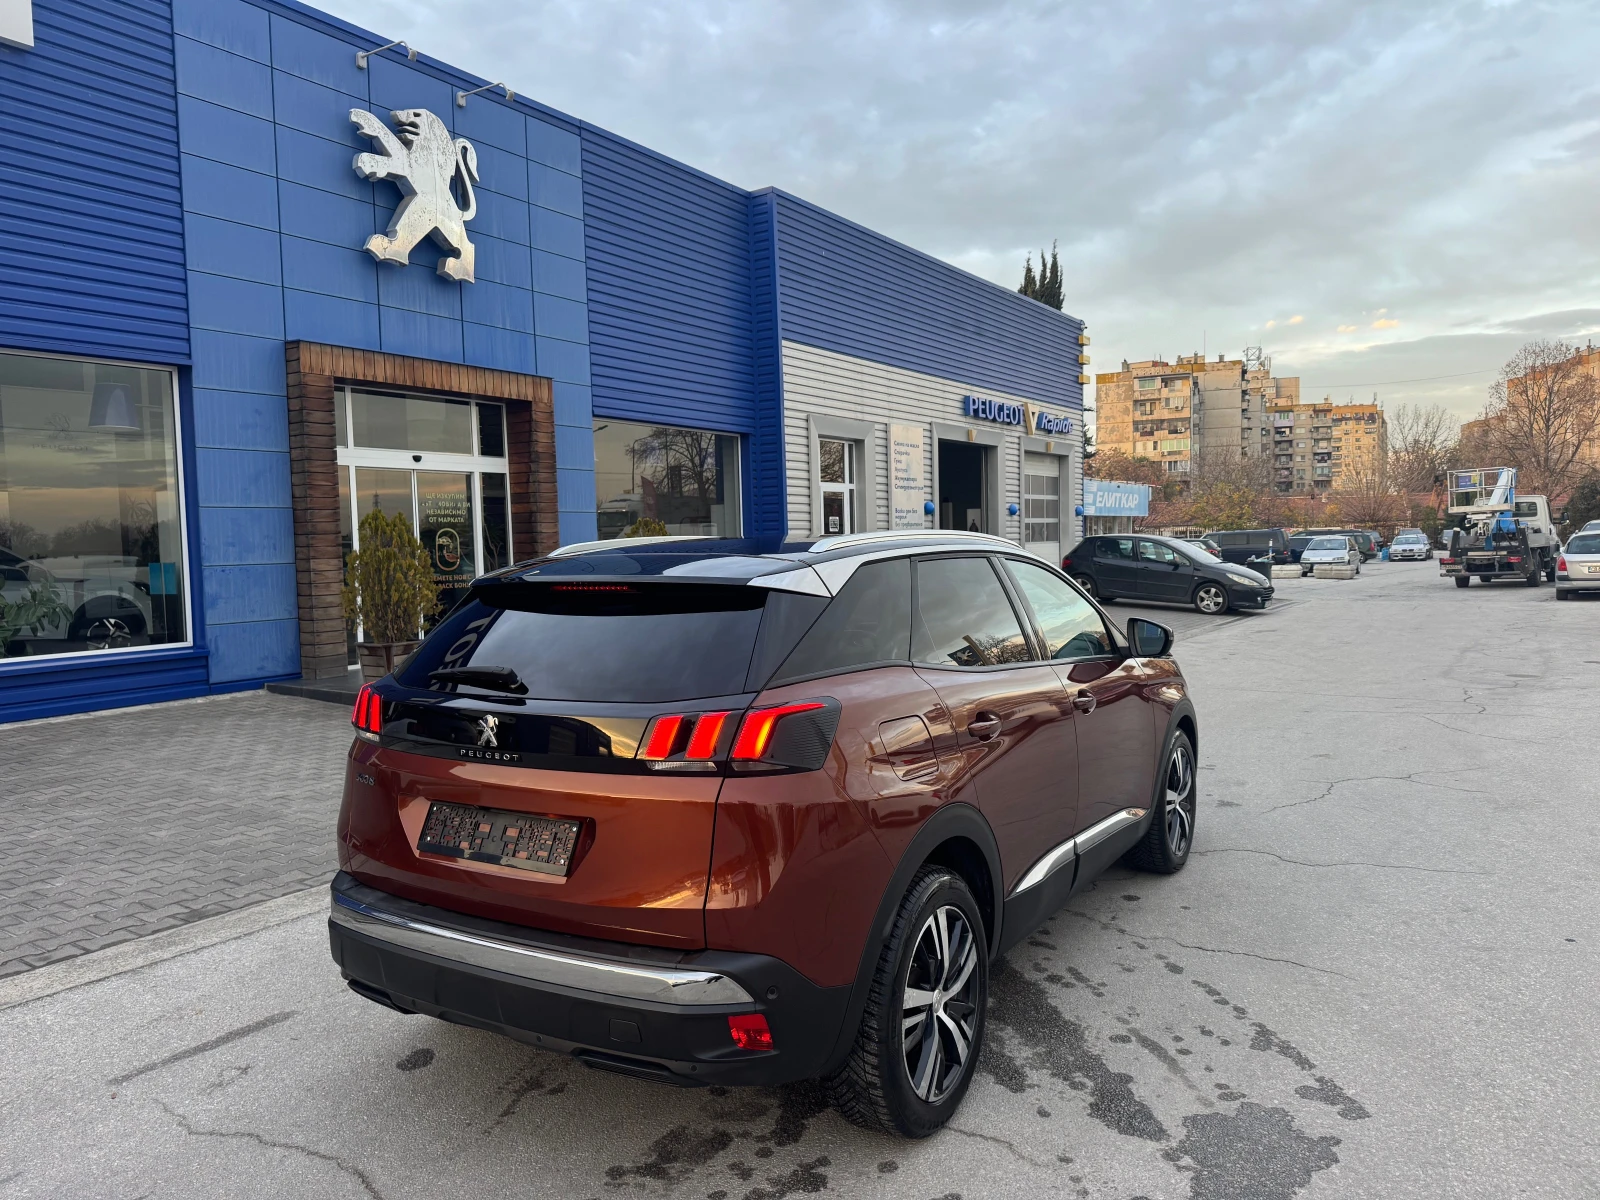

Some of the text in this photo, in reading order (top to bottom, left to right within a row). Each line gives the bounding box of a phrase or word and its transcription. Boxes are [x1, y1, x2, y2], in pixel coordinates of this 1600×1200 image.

[966, 395, 1074, 434] PEUGEOT Rapide
[460, 749, 519, 762] PEUGEOT
